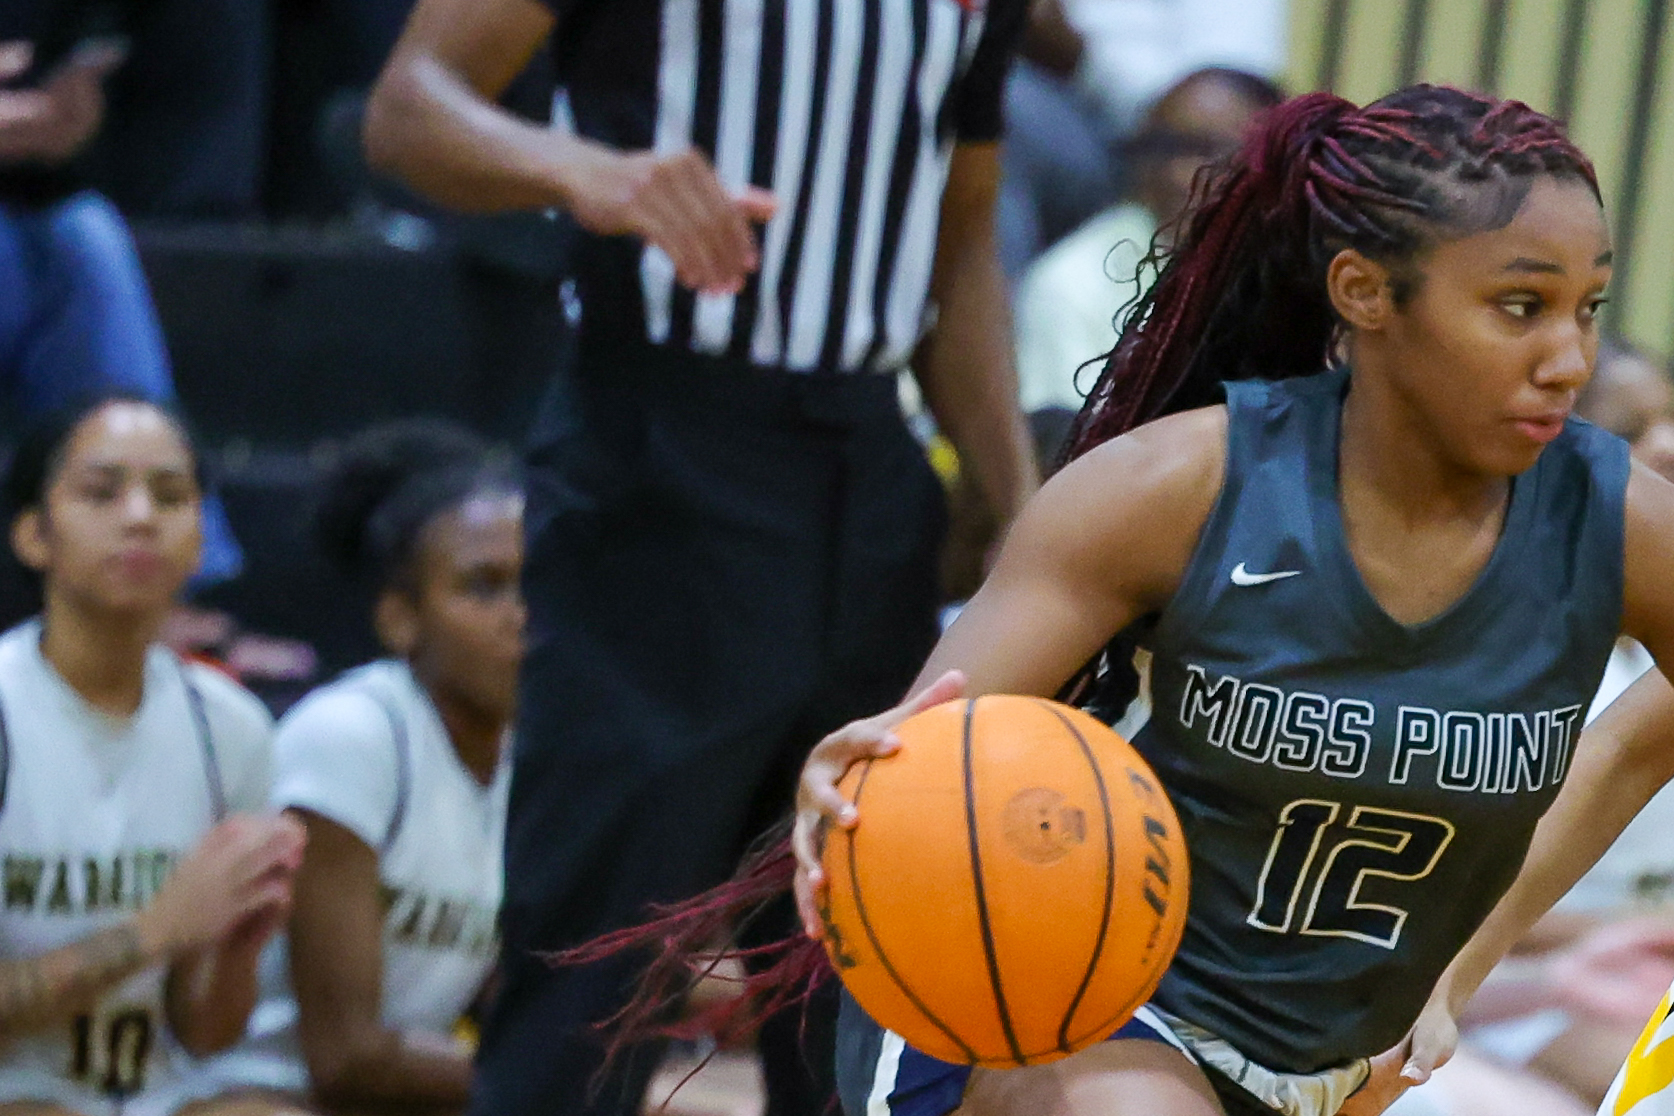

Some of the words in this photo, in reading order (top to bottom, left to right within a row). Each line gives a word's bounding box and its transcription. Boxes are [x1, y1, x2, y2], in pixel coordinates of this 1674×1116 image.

[1179, 663, 1375, 779] MOSS
[1388, 703, 1583, 794] POINT
[1246, 798, 1456, 950] 12
[71, 1008, 153, 1097] 10
